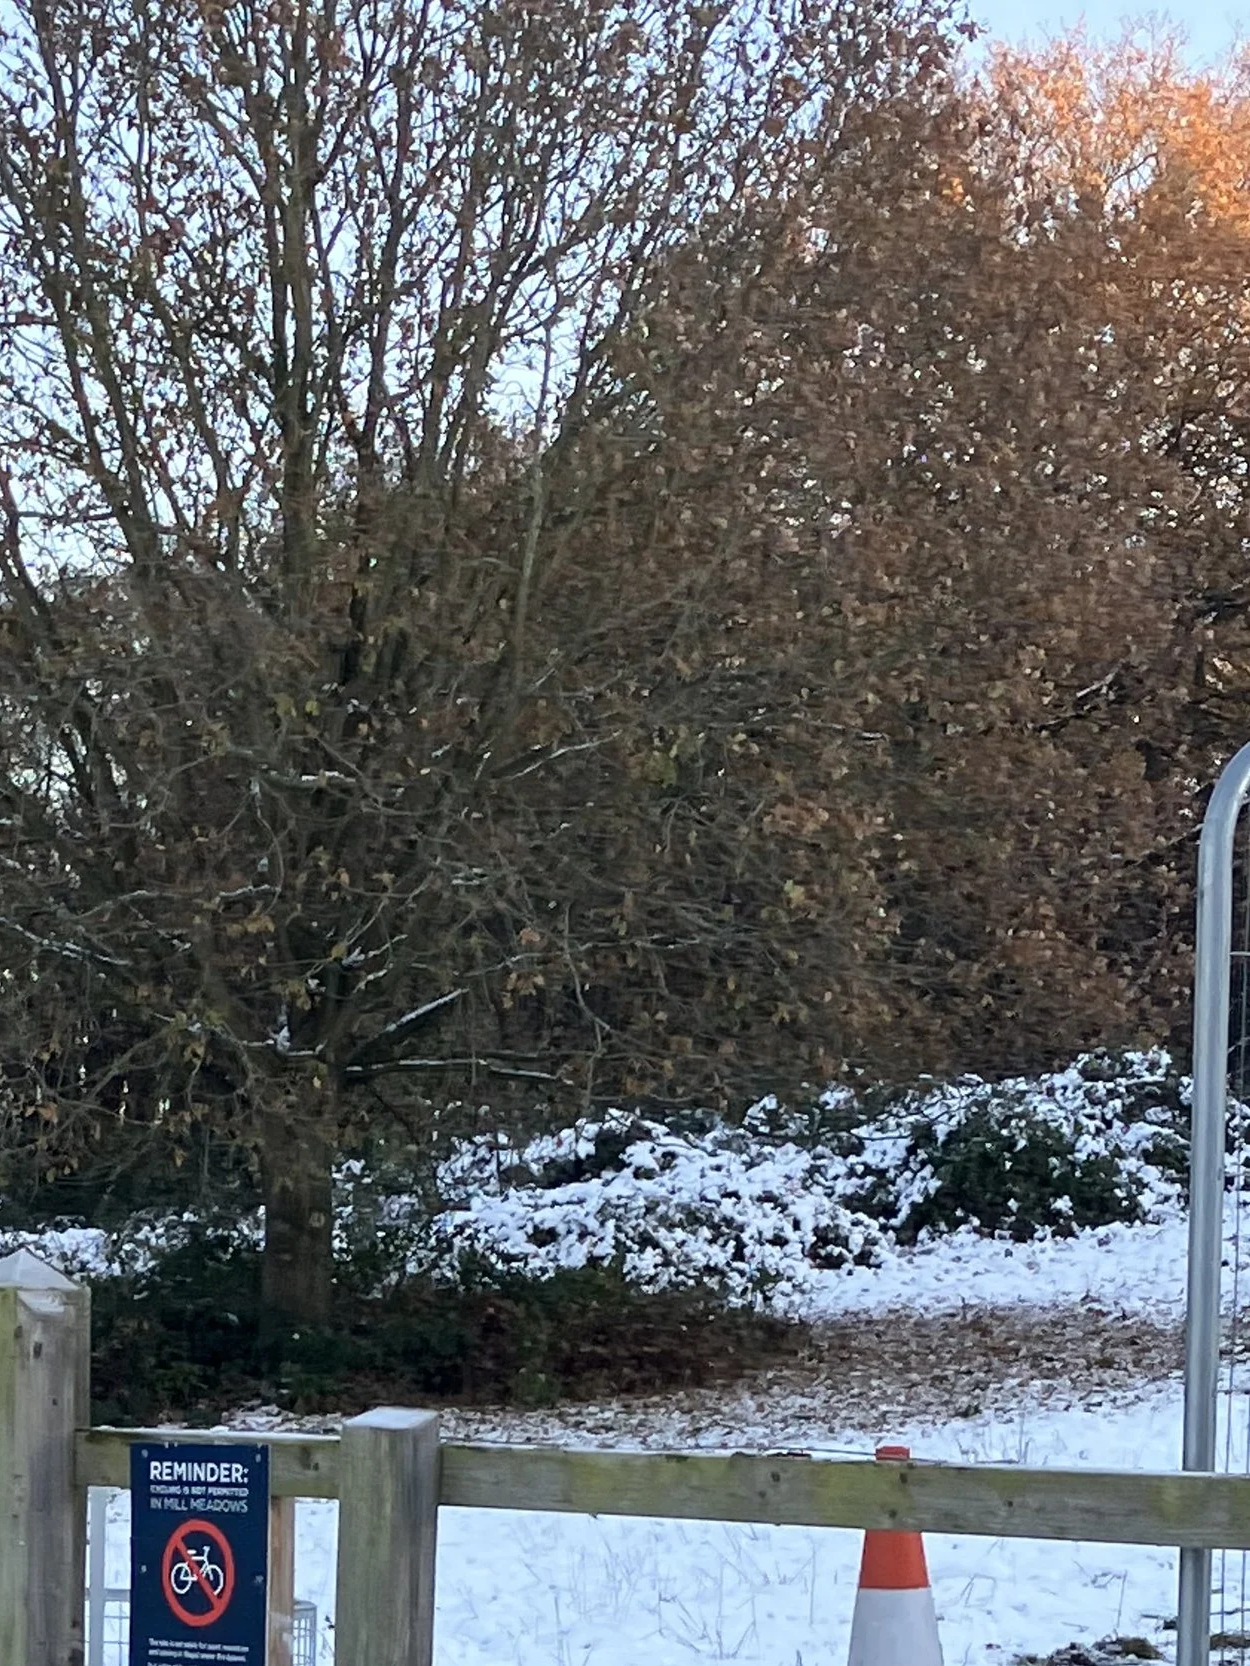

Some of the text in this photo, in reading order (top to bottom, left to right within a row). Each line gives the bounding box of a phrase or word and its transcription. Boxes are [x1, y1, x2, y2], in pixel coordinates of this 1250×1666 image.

[150, 1461, 249, 1484] REMINDER:
[150, 1497, 248, 1513] IN MILL MEADOWS
